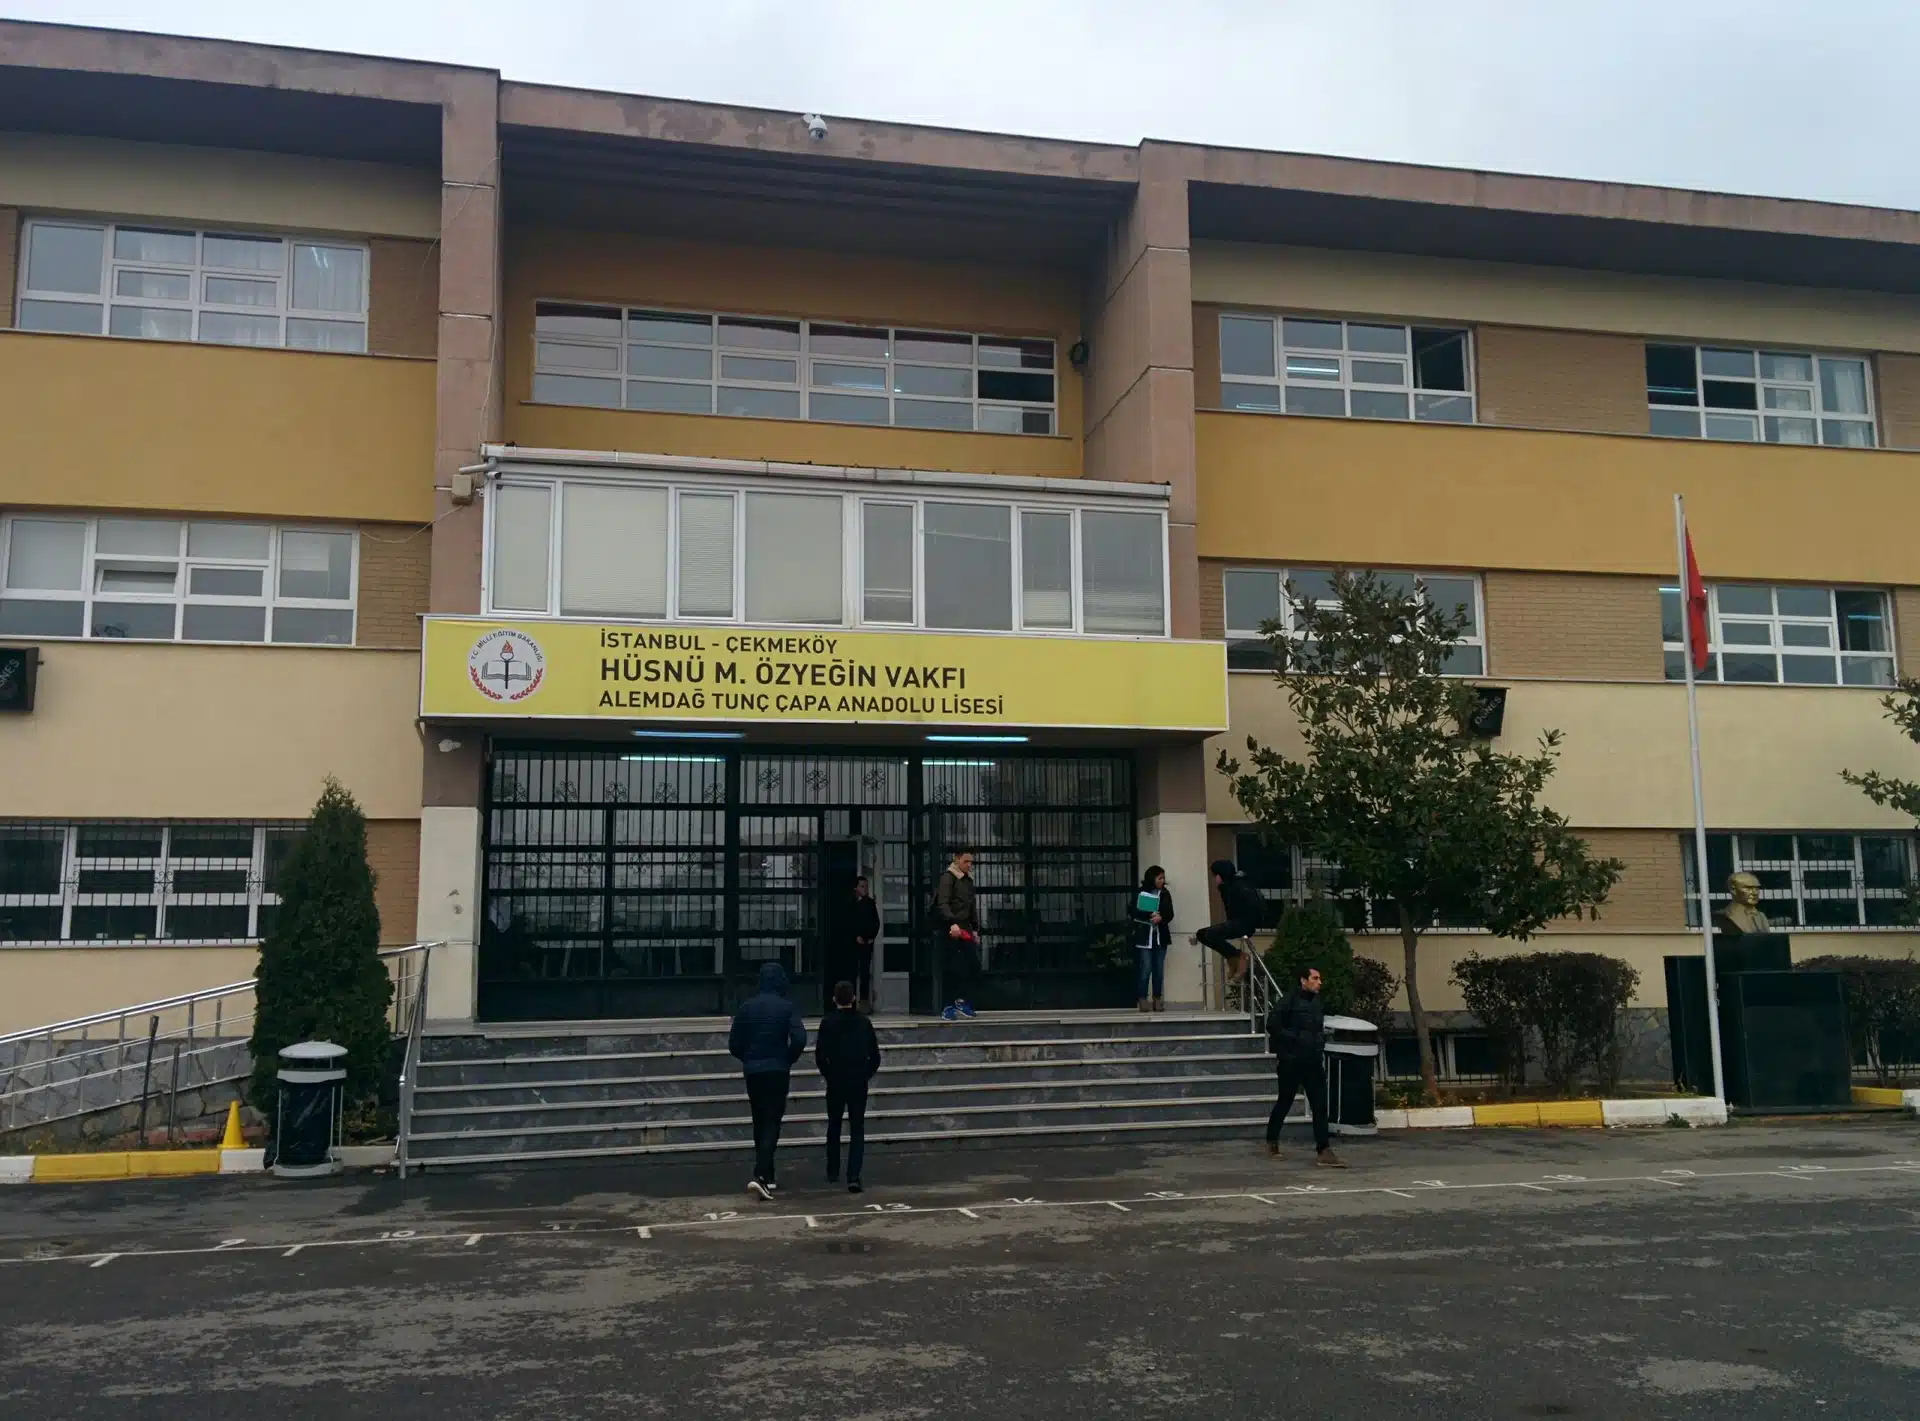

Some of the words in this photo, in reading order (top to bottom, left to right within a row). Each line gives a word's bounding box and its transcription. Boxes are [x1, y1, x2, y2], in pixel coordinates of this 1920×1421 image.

[600, 627, 706, 651] İSTANBUL
[726, 634, 838, 655] ÇEKMEKÖY
[601, 652, 705, 684] HÜSNÜ
[715, 661, 746, 685] M.
[756, 656, 876, 688] ÖZYEĞİN
[884, 665, 965, 690] VAKFI
[598, 688, 705, 709] ALEMDAĞ
[711, 692, 770, 713] TUNÇ
[775, 694, 832, 713] ÇAPA
[836, 695, 935, 714] ANADOLU
[941, 693, 1003, 715] LİSESİ
[703, 1211, 746, 1220] 12
[864, 1202, 911, 1211] 13
[376, 1230, 415, 1239] 10
